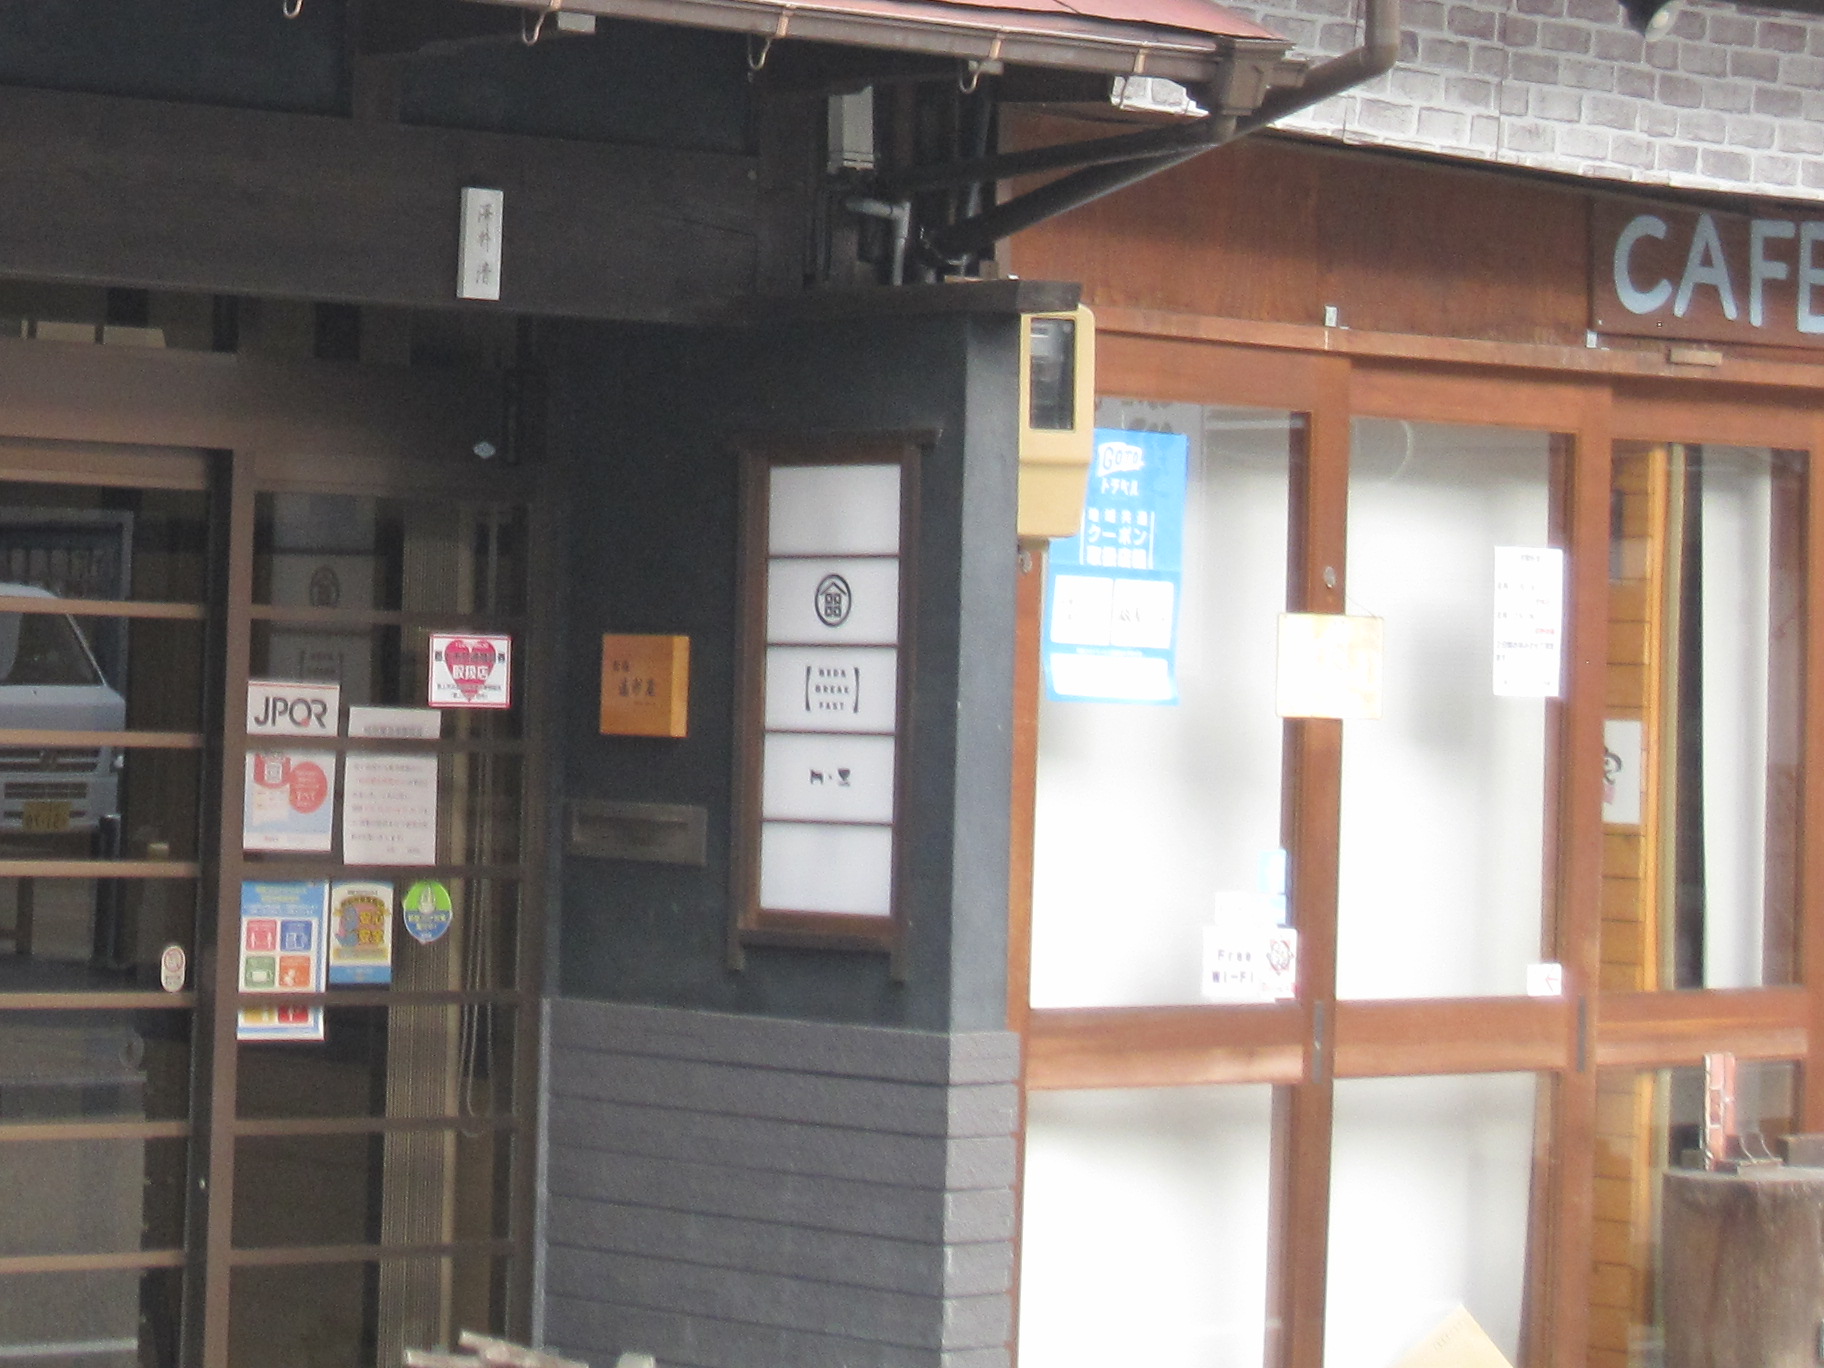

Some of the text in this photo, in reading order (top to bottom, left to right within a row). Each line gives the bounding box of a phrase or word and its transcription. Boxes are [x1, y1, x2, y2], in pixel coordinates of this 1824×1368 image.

[1614, 212, 1824, 334] CAFE
[1101, 477, 1140, 497] トラベル
[1087, 524, 1148, 546] クーポン
[815, 685, 849, 694] BREAK
[254, 696, 328, 729] JPQR
[819, 701, 845, 710] FAST
[1217, 948, 1251, 962] Free
